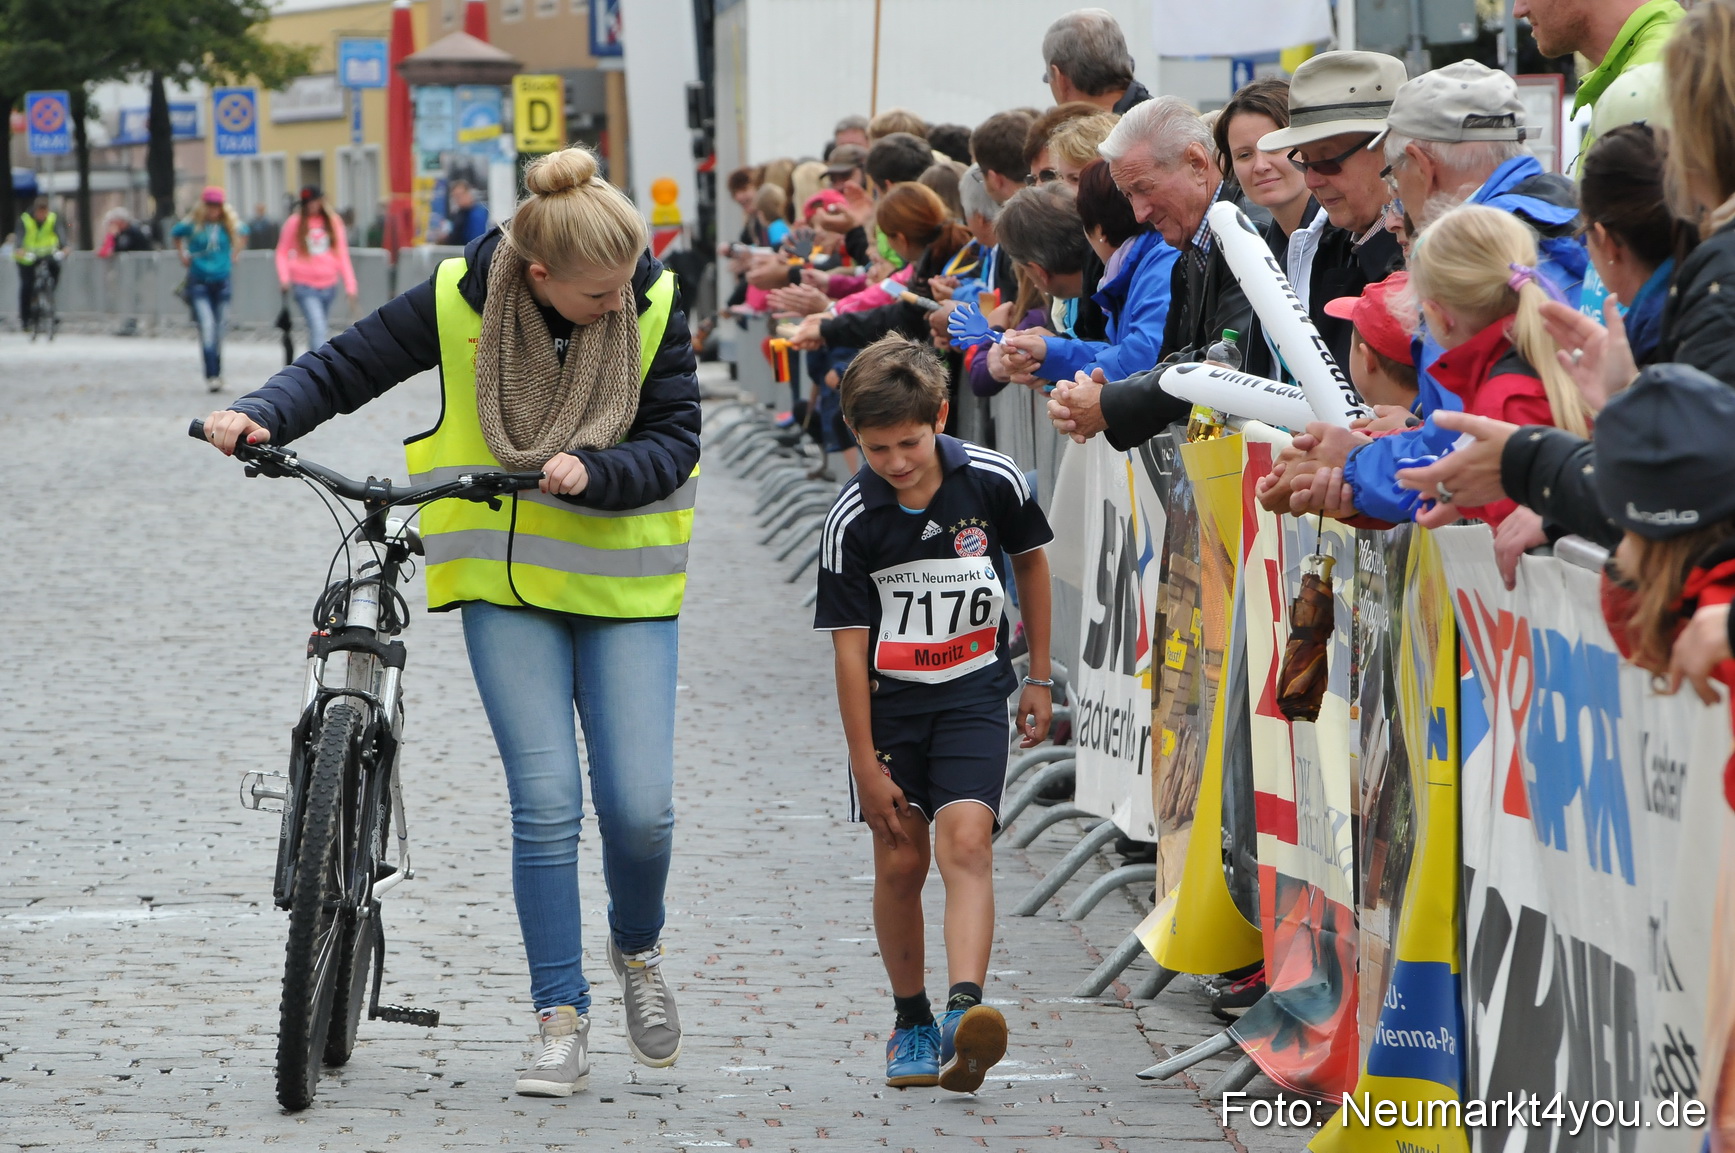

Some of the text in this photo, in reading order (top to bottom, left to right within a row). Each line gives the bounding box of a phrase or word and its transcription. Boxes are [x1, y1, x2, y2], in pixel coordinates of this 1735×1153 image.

[529, 99, 552, 132] D
[877, 570, 981, 585] PARTL Neumarkt
[892, 587, 993, 636] 7176
[884, 632, 889, 640] 6
[914, 645, 964, 666] Moritz
[1375, 1020, 1457, 1056] Vienna-Pa
